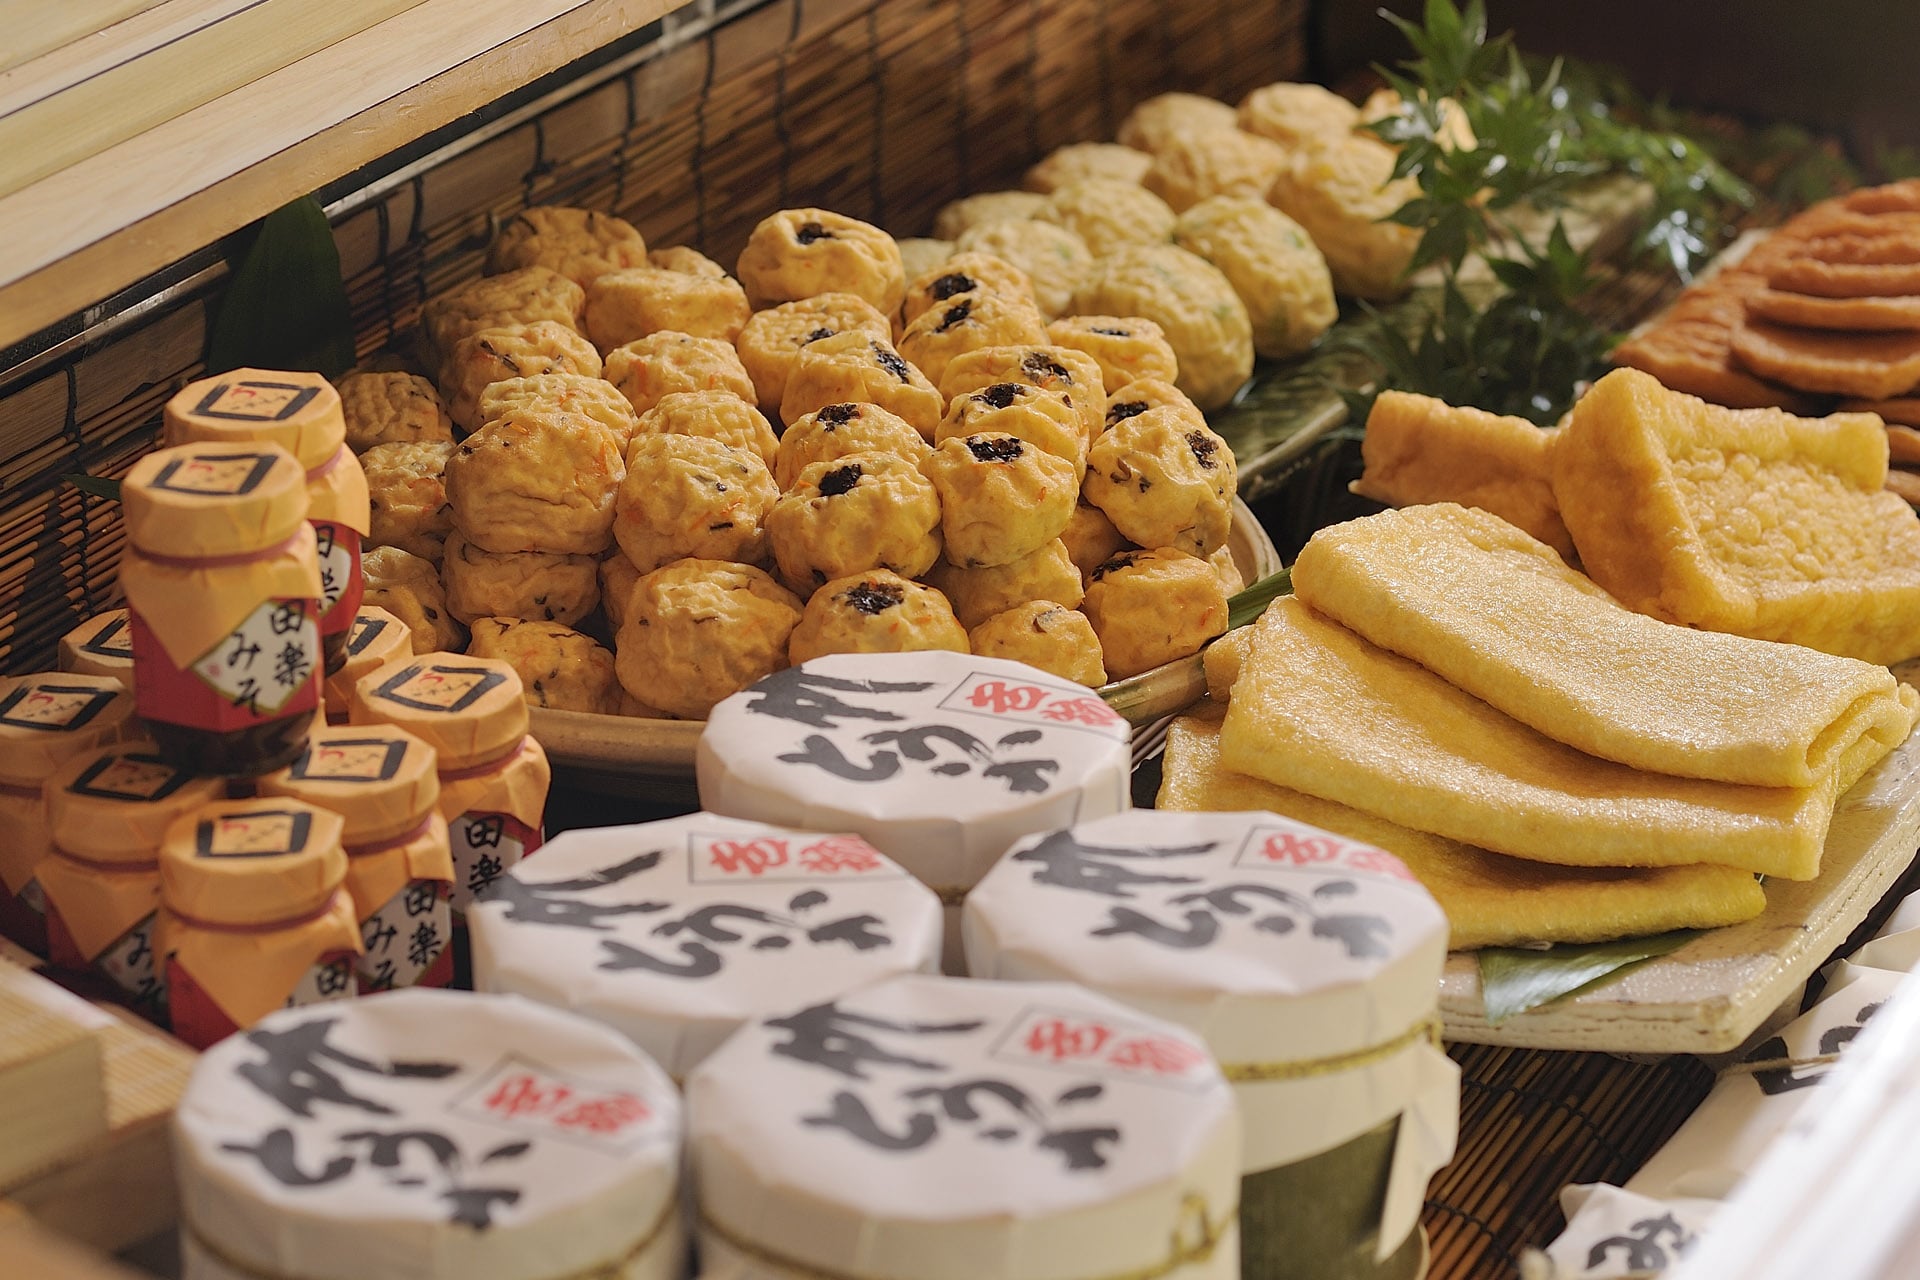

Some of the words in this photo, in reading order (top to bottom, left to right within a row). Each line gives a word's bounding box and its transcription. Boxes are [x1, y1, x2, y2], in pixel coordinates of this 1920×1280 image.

[227, 631, 262, 717] みそ
[270, 599, 310, 687] 田楽
[776, 724, 1060, 794] とうふ
[464, 814, 505, 898] 田楽
[364, 916, 397, 990] みそ
[404, 879, 441, 967] 田楽
[597, 888, 893, 979] とうふ
[1089, 879, 1395, 960] とうふ
[800, 1078, 1123, 1172] とうふ
[220, 1126, 533, 1232] とうふ
